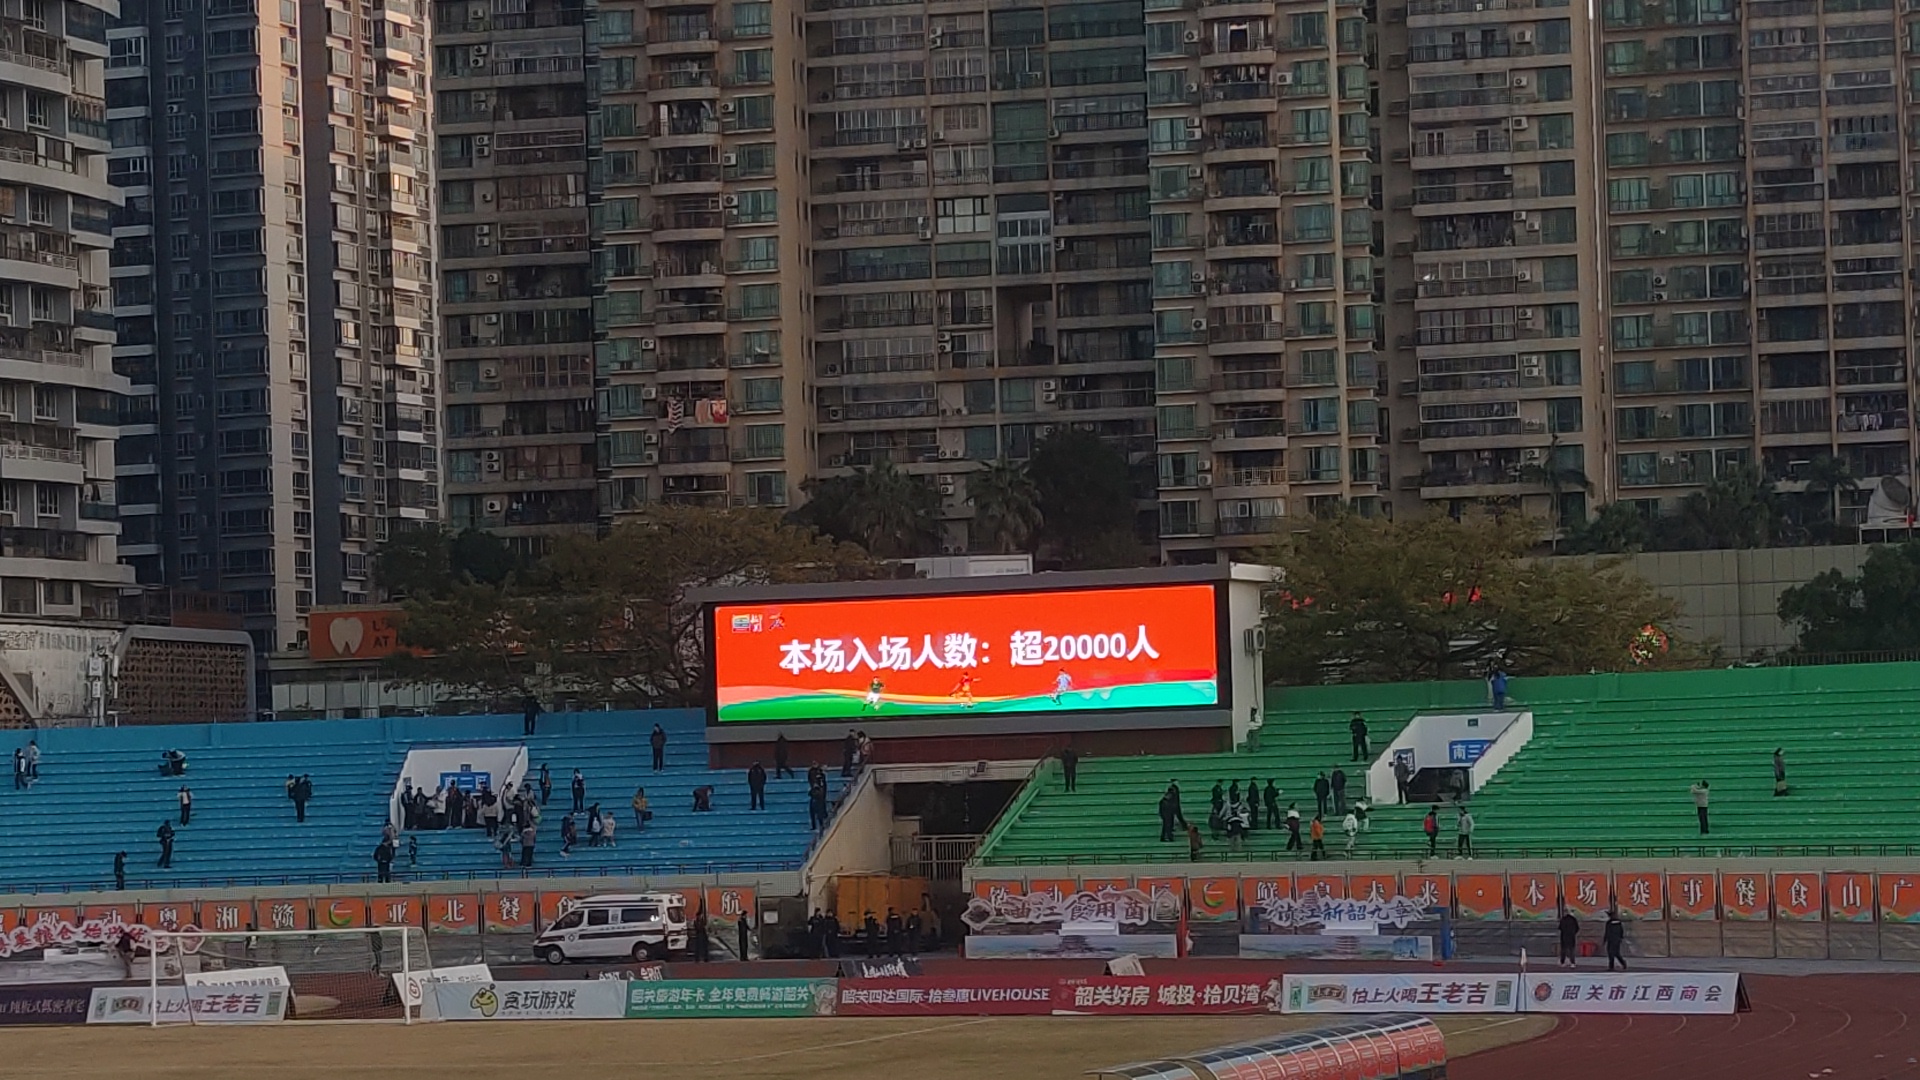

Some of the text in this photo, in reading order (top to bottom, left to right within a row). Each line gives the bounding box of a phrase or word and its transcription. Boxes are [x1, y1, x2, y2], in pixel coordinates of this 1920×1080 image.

[1452, 744, 1492, 761] 南三
[721, 891, 743, 915] 航
[504, 989, 577, 1010] 贪玩游戏
[1075, 984, 1150, 1006] 韶关好房
[1352, 982, 1490, 1006] 怕上火喝王老吉
[1561, 984, 1723, 1002] 韶关市江西商会
